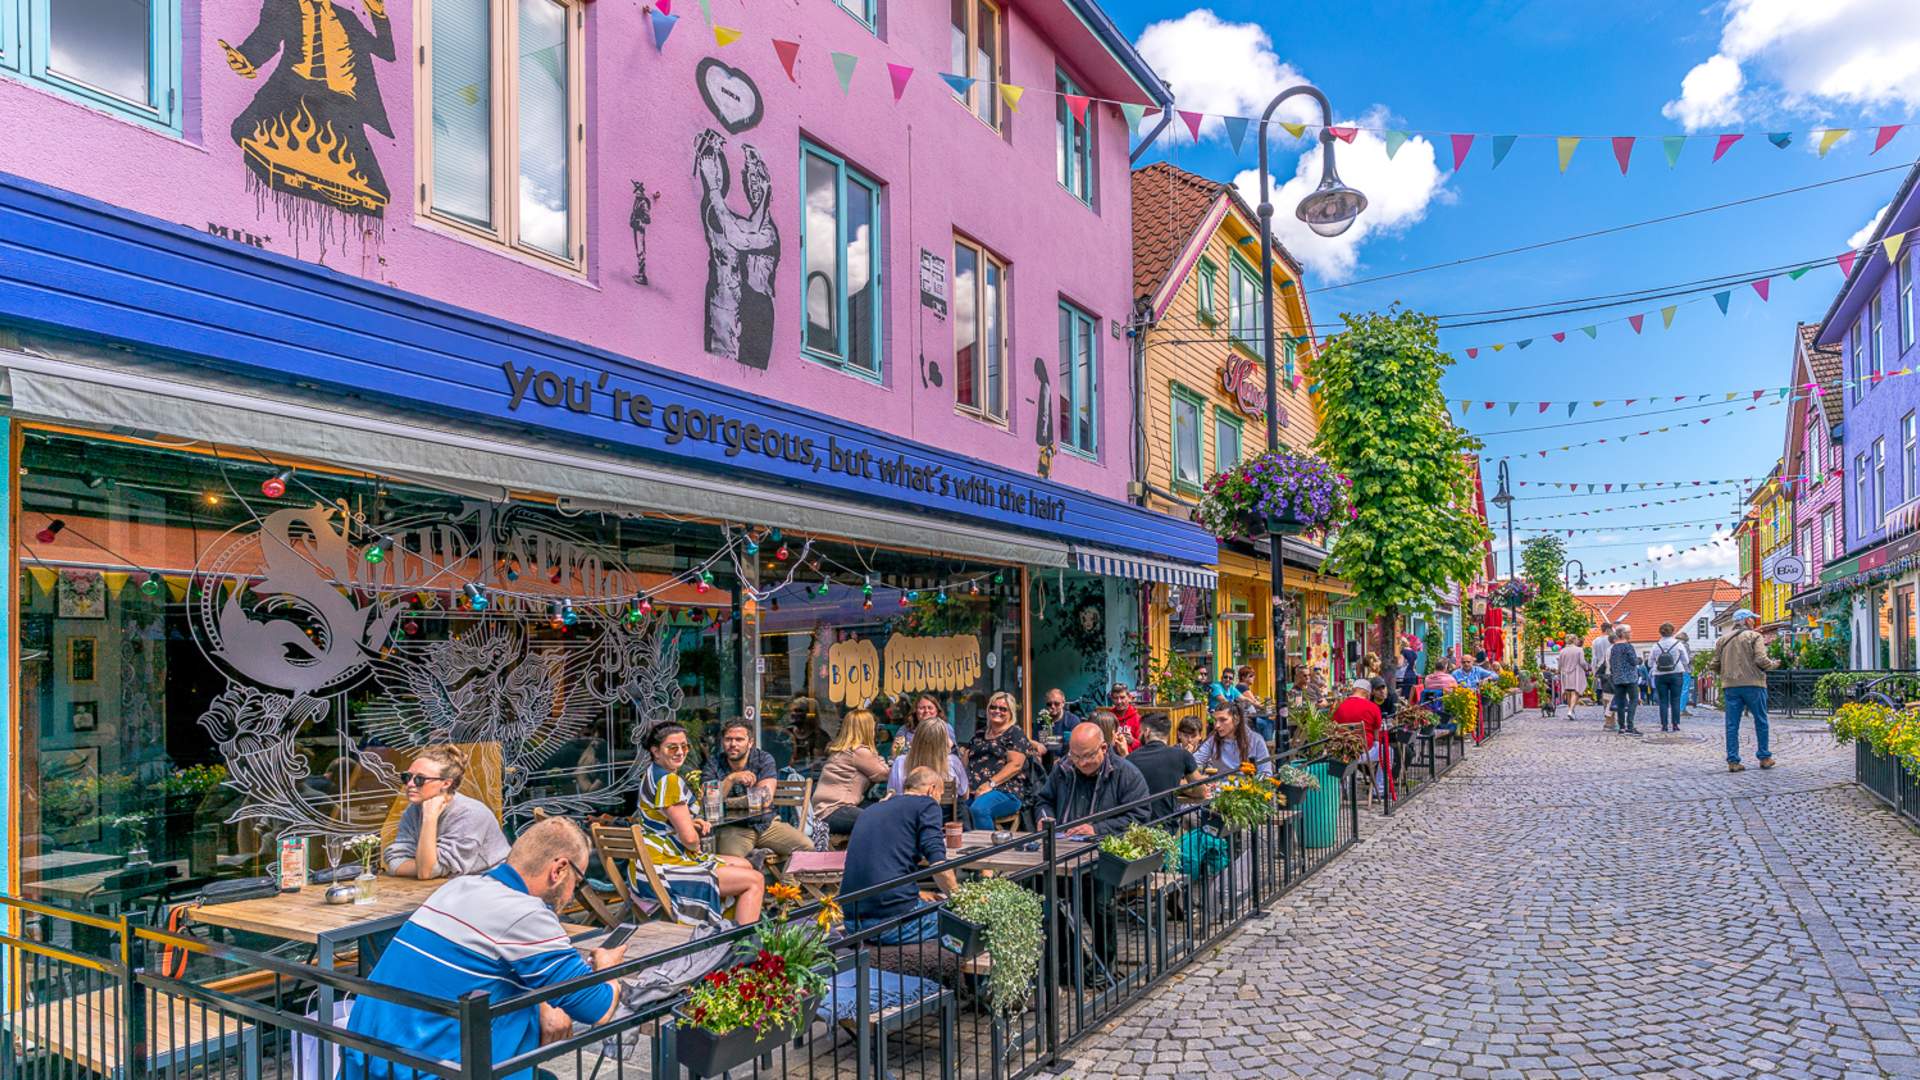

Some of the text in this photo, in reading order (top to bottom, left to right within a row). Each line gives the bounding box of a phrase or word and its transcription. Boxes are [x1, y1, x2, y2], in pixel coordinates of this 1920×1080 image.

[503, 360, 1067, 522] you're gorgeous, but what's with the hair?
[832, 652, 980, 685] BOB STYLISTER
